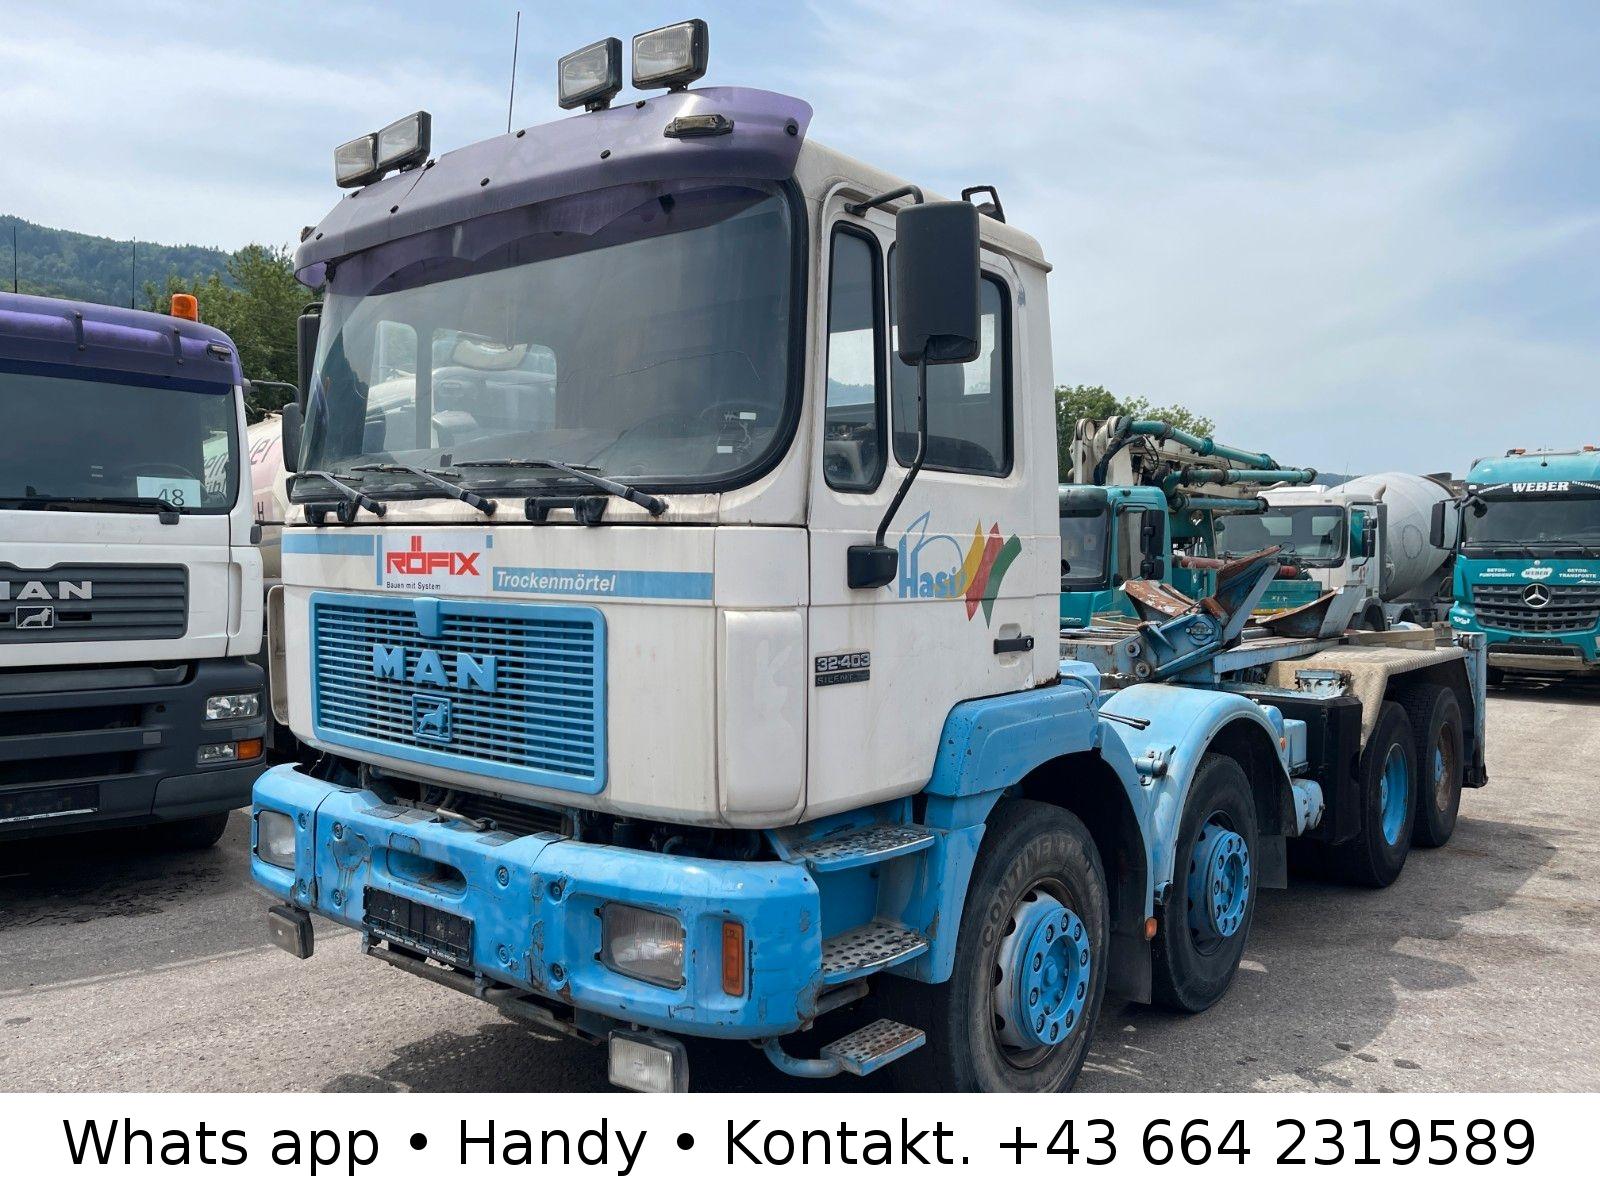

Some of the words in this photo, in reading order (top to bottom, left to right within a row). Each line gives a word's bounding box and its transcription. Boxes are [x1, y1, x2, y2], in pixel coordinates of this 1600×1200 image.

[1511, 480, 1570, 493] WEBER
[157, 488, 186, 507] 48
[386, 535, 480, 576] RÖFIX
[386, 581, 405, 589] Bauen
[417, 582, 441, 591] System
[496, 571, 616, 592] Trockenmörtel
[372, 643, 497, 692] MAN
